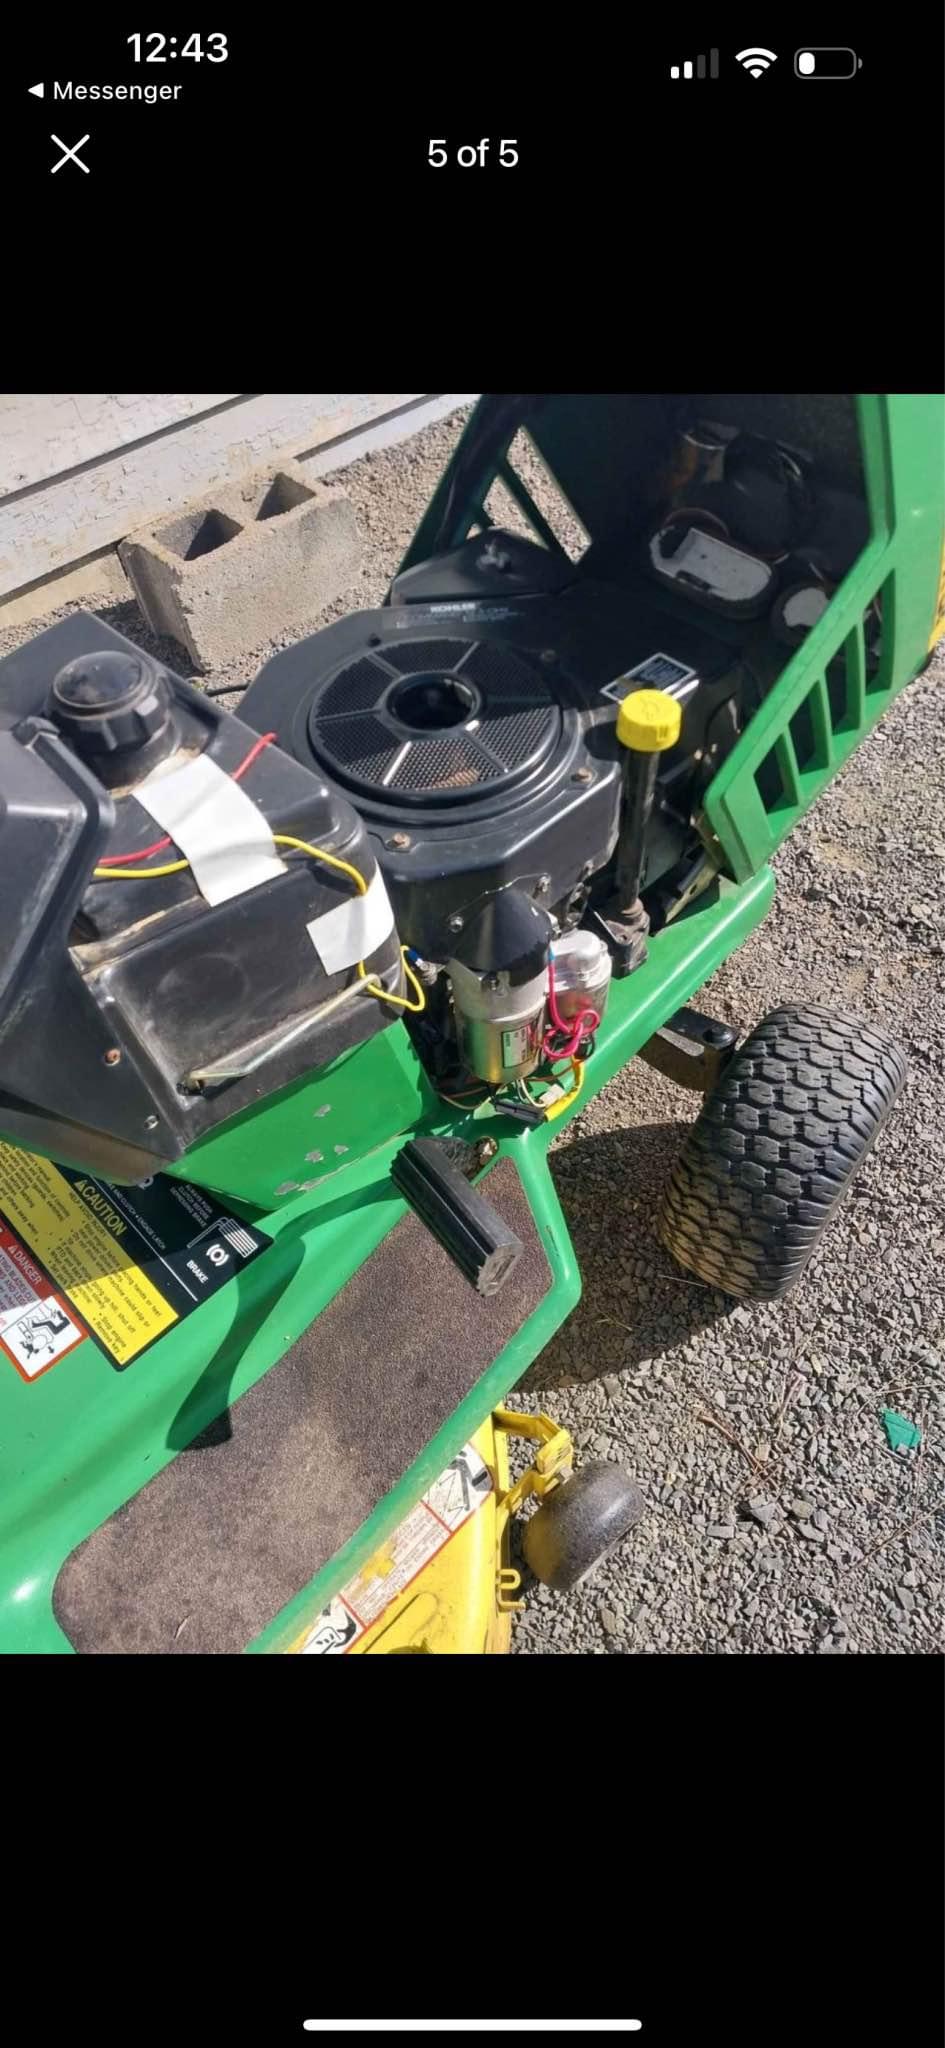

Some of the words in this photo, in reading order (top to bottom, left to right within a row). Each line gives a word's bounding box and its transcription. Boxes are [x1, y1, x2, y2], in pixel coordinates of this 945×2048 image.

[430, 602, 476, 613] KOHLER
[80, 1185, 128, 1237] CAUTION
[13, 1251, 43, 1285] DANGER
[186, 1258, 209, 1284] BRAKE
